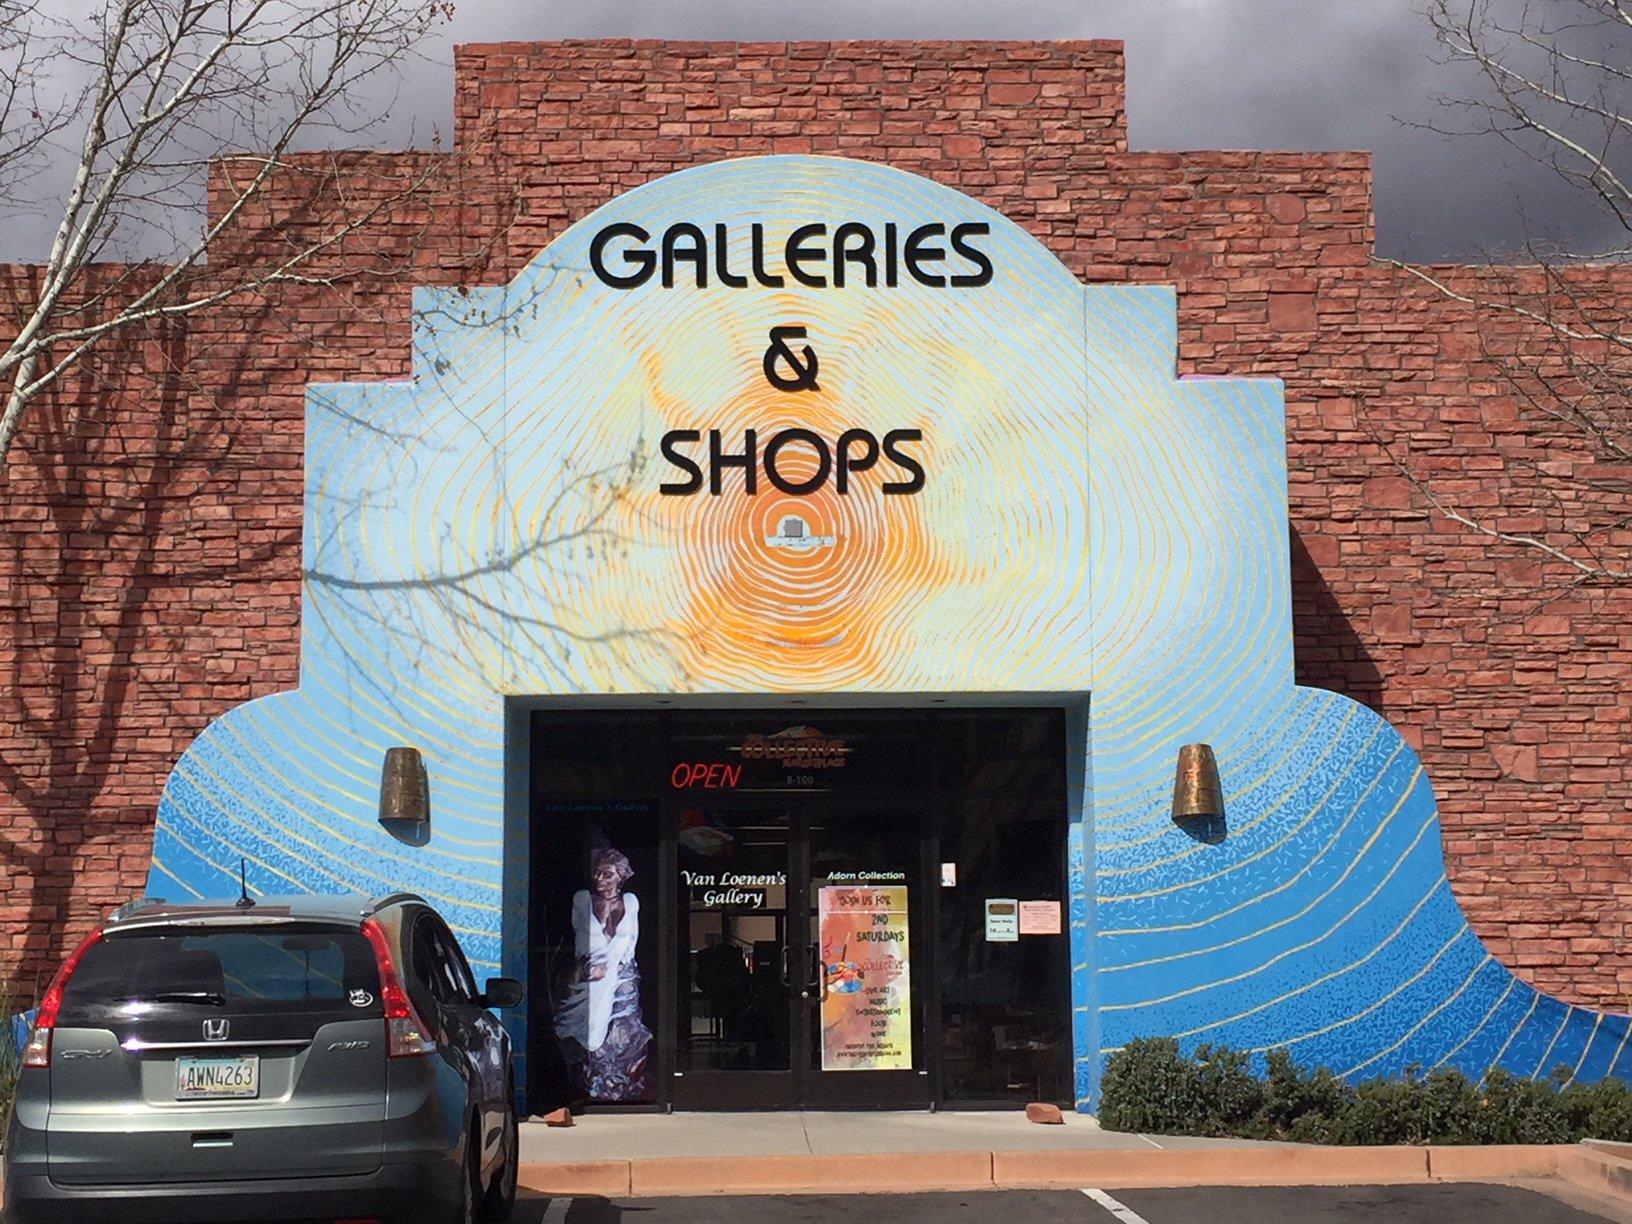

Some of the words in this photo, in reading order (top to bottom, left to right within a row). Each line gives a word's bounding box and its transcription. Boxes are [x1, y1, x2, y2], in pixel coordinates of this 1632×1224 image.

[589, 222, 994, 290] GALLERIES
[763, 326, 821, 392] &
[660, 428, 926, 496] SHOPS
[671, 763, 743, 788] OPEN
[681, 870, 715, 886] Van
[719, 871, 787, 886] Loenen's
[827, 871, 856, 880] Adorn
[858, 871, 906, 880] Collection
[704, 888, 763, 908] Gallery
[856, 930, 905, 942] SATURDAYS
[187, 1066, 253, 1087] AWN4263
